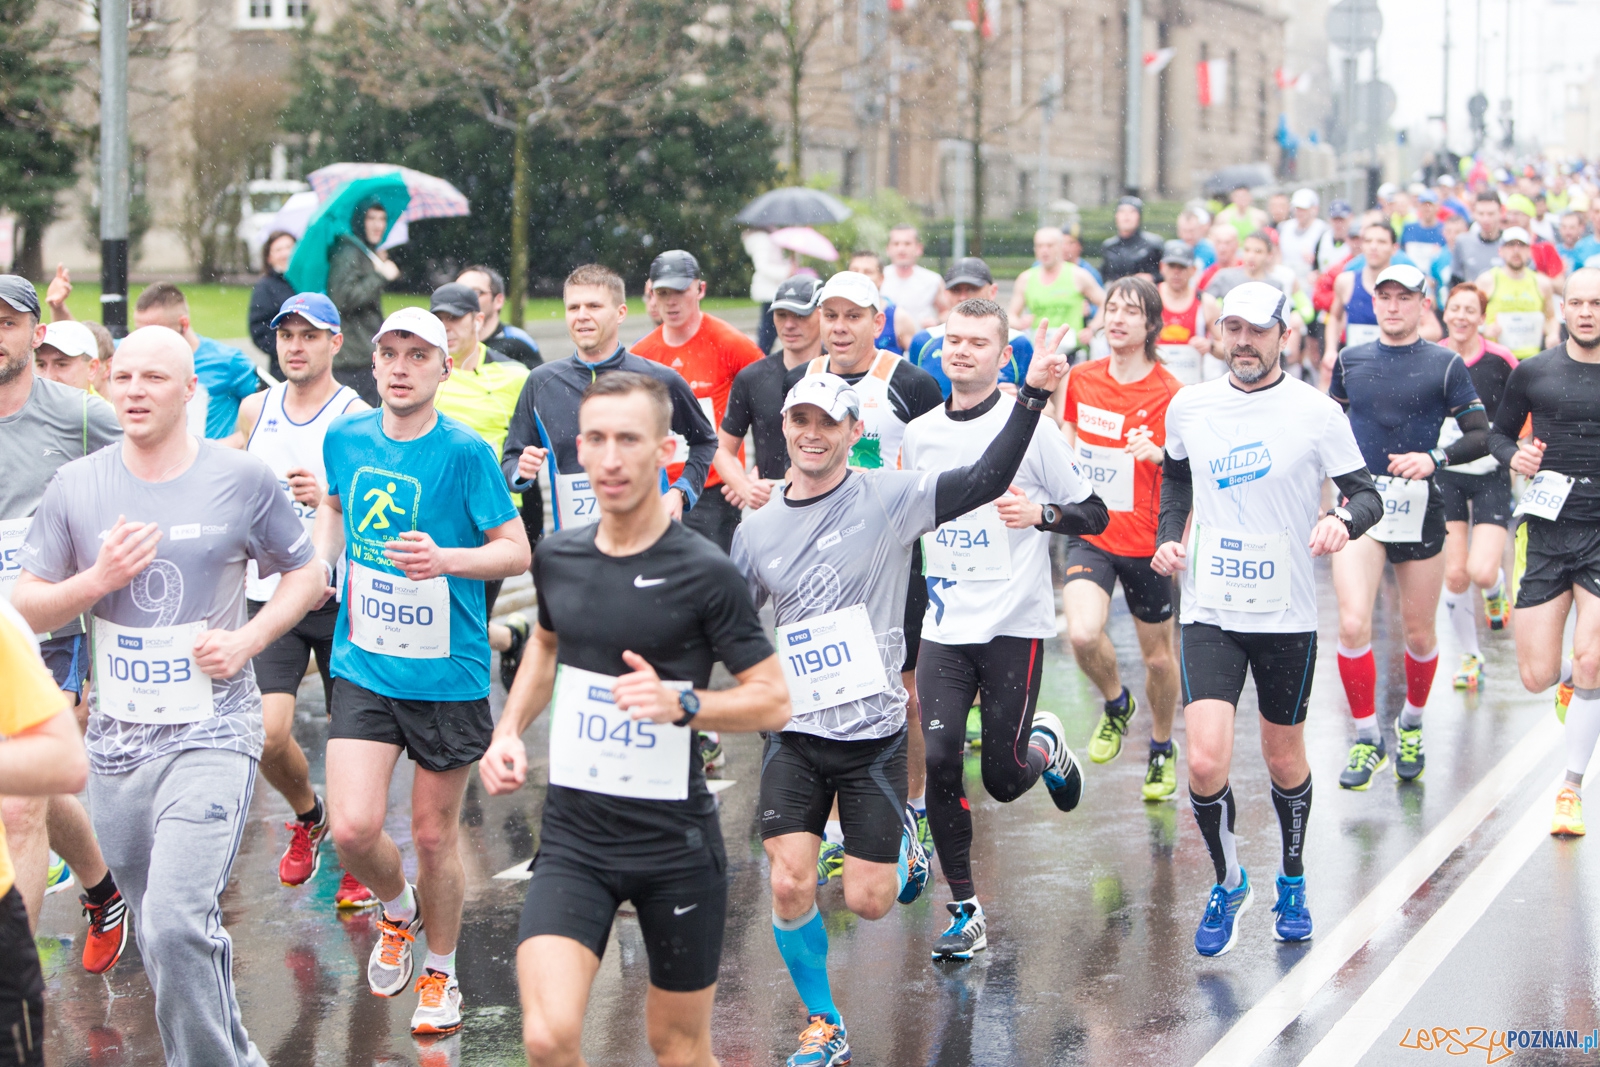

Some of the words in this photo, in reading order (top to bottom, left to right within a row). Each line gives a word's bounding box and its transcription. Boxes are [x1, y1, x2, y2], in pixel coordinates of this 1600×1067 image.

[1078, 461, 1117, 483] 087
[1208, 448, 1272, 475] WILDA
[572, 497, 597, 515] 27
[1385, 499, 1411, 515] 94
[935, 528, 990, 549] 4734
[1210, 555, 1275, 580] 3360
[1225, 581, 1257, 589] Krzysztof
[361, 594, 434, 626] 10960
[107, 653, 192, 684] 10033
[788, 641, 852, 677] 11901
[132, 686, 160, 697] Maciej
[577, 711, 657, 748] 1045
